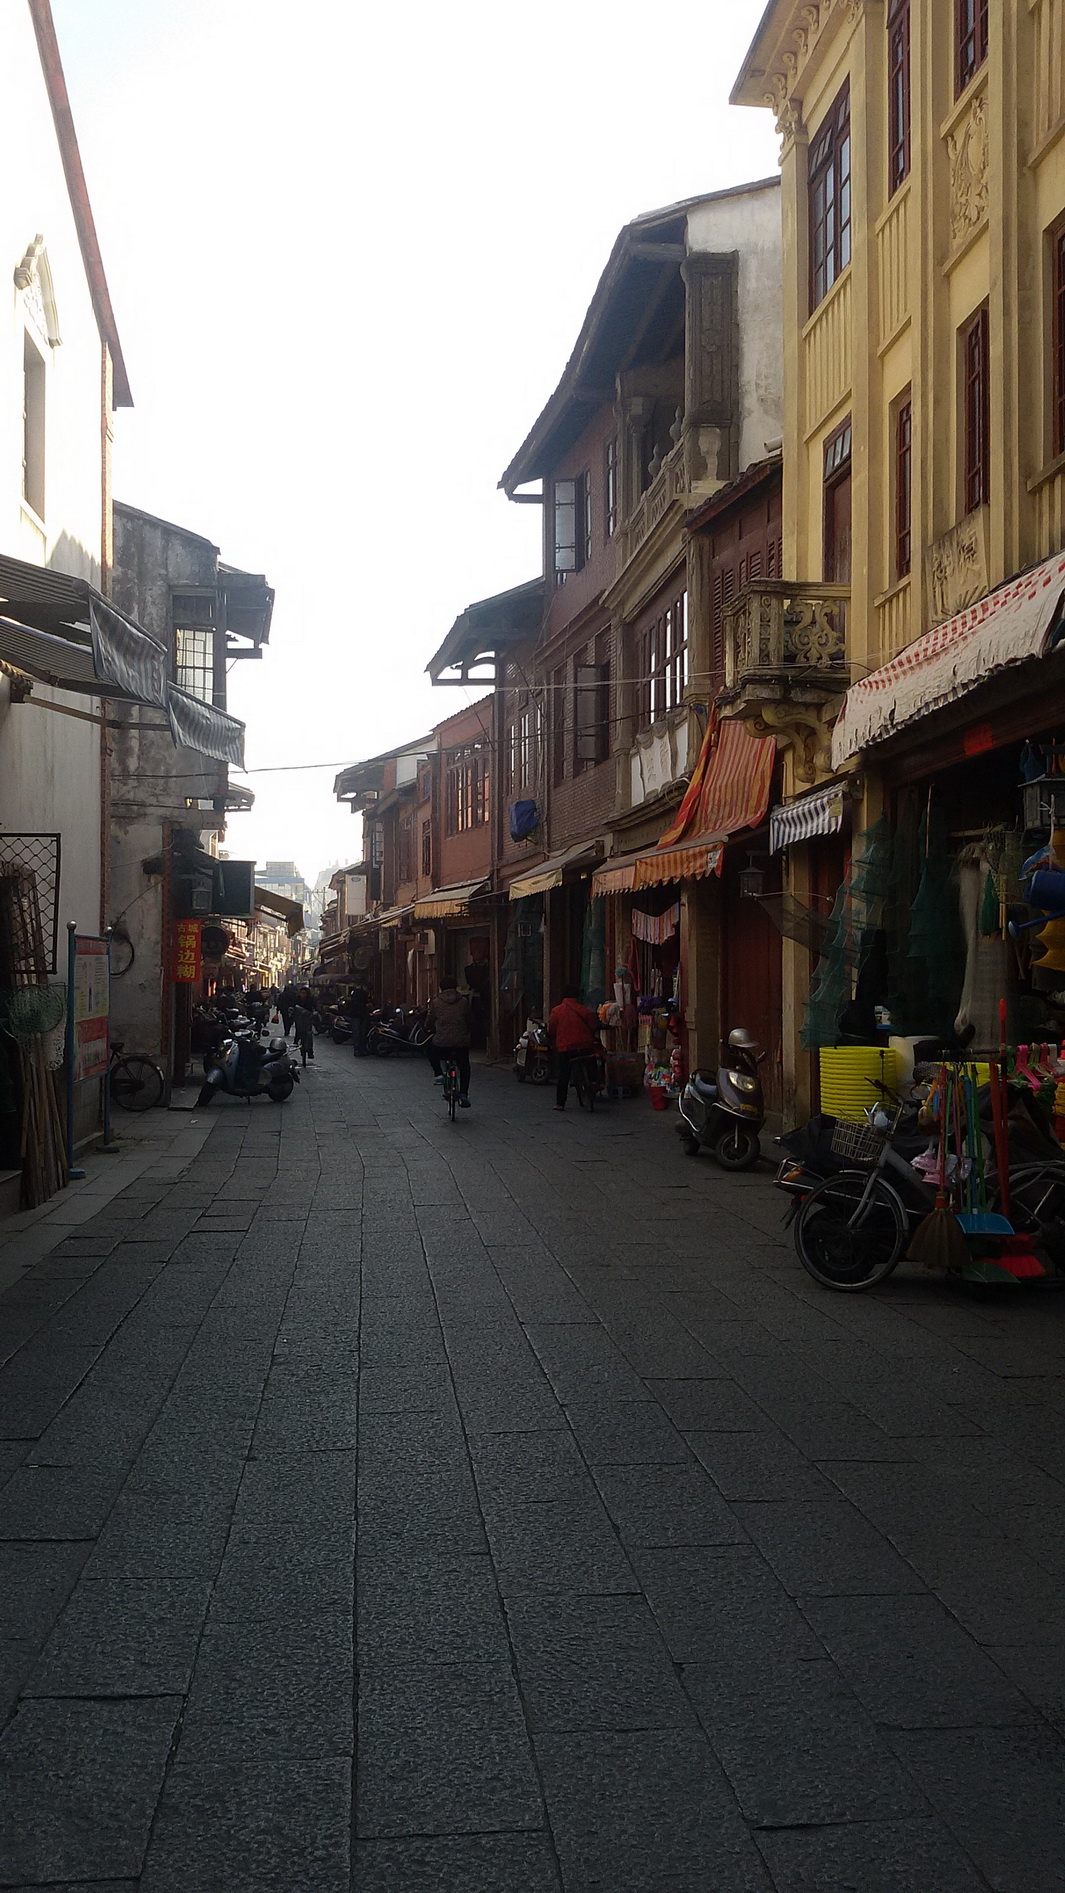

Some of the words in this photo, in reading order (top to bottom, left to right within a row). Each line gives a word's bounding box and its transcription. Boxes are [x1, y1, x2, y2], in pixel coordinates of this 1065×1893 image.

[177, 923, 198, 933] 古城
[177, 935, 196, 979] 锅边糊
